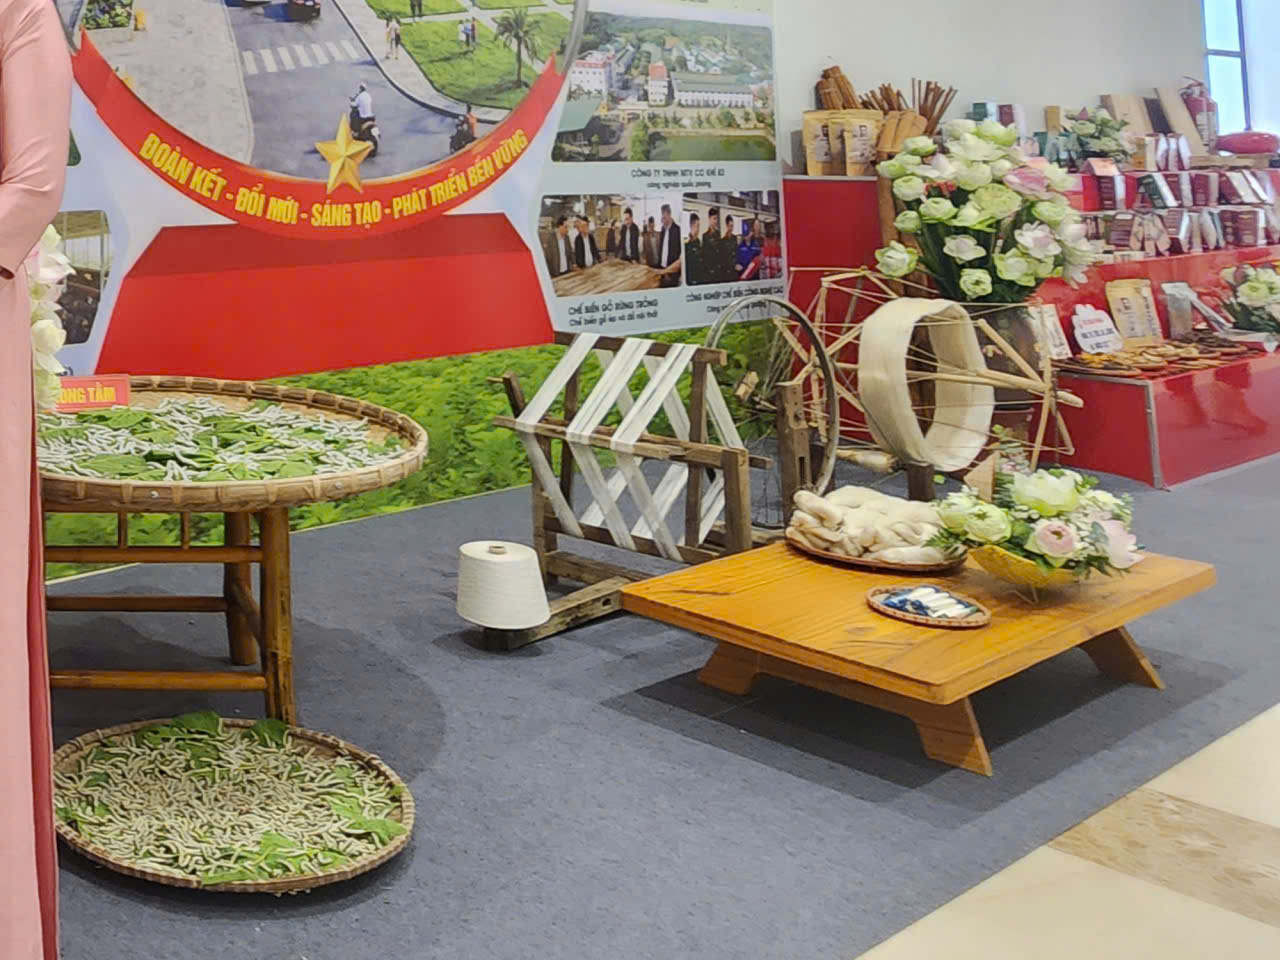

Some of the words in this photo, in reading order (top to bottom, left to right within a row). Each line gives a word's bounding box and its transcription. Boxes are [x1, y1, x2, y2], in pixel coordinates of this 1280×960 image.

[138, 132, 195, 185] ĐOÀN
[189, 166, 228, 201] KẾT
[234, 183, 266, 217] ĐỔI
[266, 196, 300, 225] MỚI
[311, 199, 352, 227] SÁNG
[353, 200, 382, 229] TẠO
[392, 188, 429, 219] PHÁT
[430, 167, 469, 206] TRIỂN
